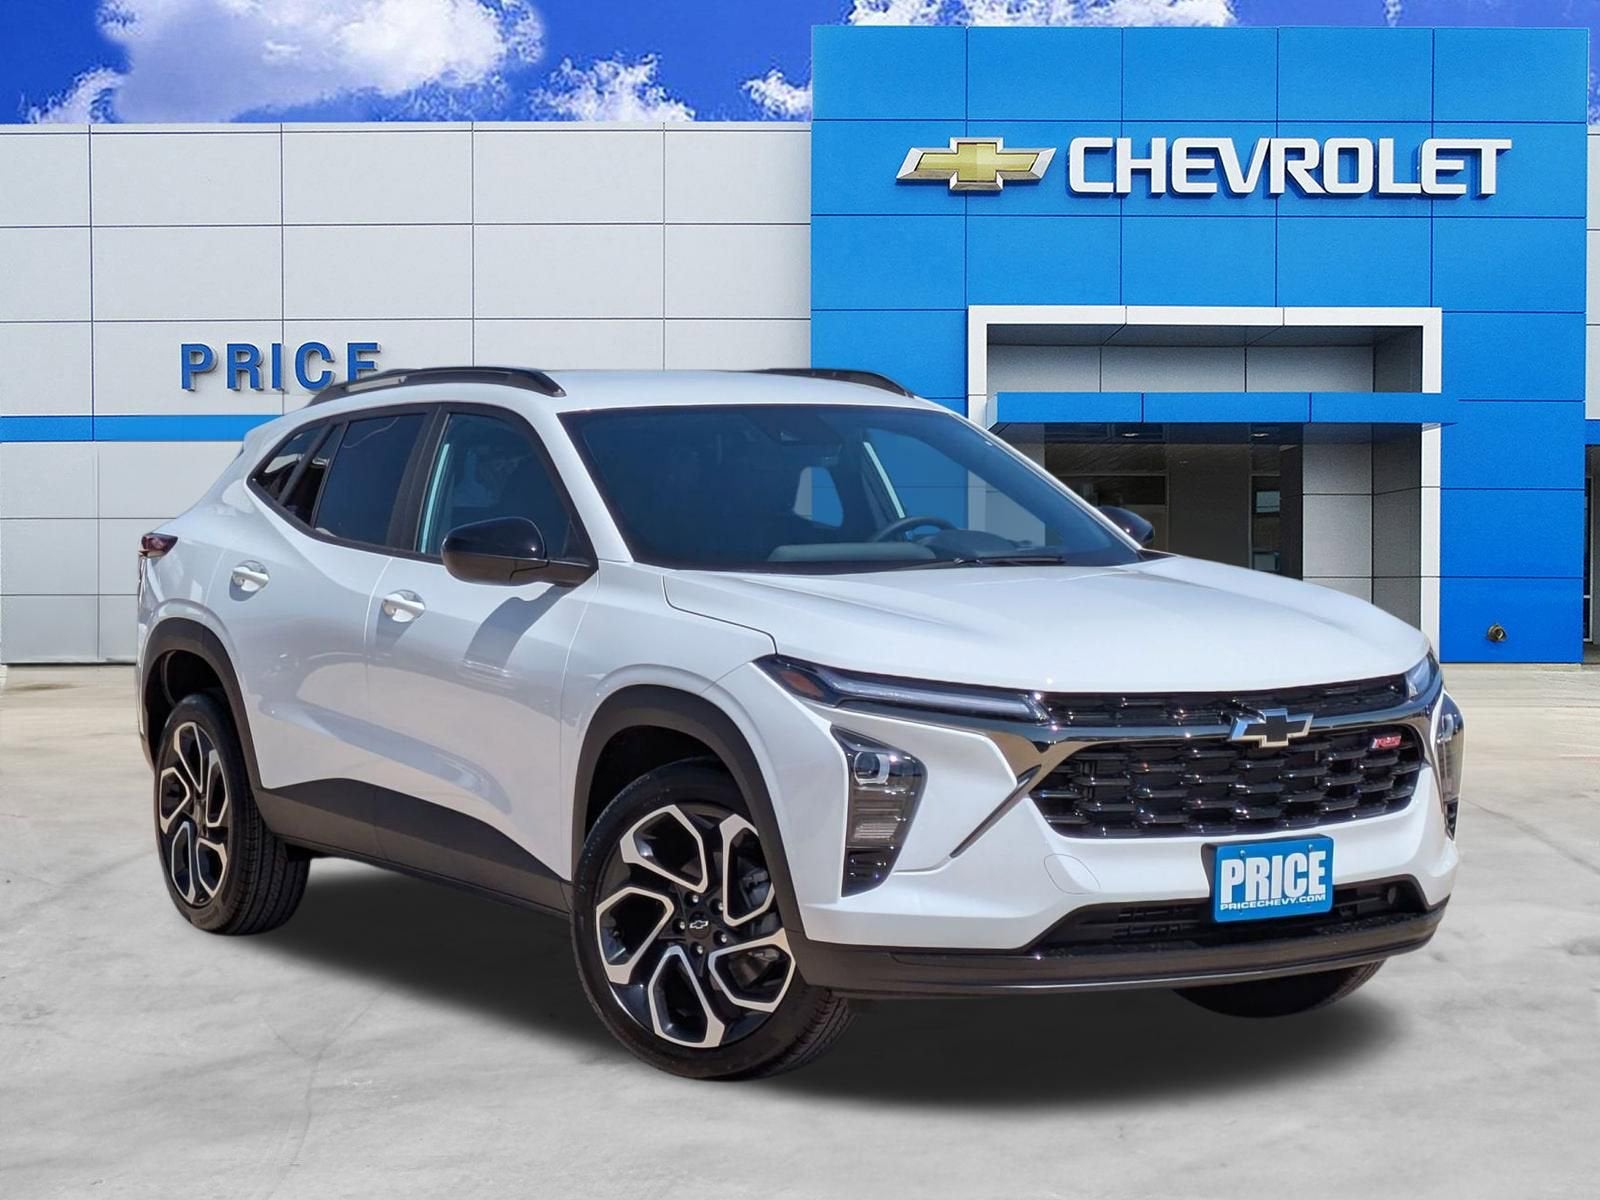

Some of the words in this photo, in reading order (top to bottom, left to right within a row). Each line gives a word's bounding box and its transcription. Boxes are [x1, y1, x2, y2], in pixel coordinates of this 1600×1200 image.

[1068, 136, 1513, 195] CHEVROLET
[180, 341, 381, 392] PRICE
[1220, 850, 1327, 904] PRICE
[1220, 894, 1326, 911] PRICECHEVY.COM
